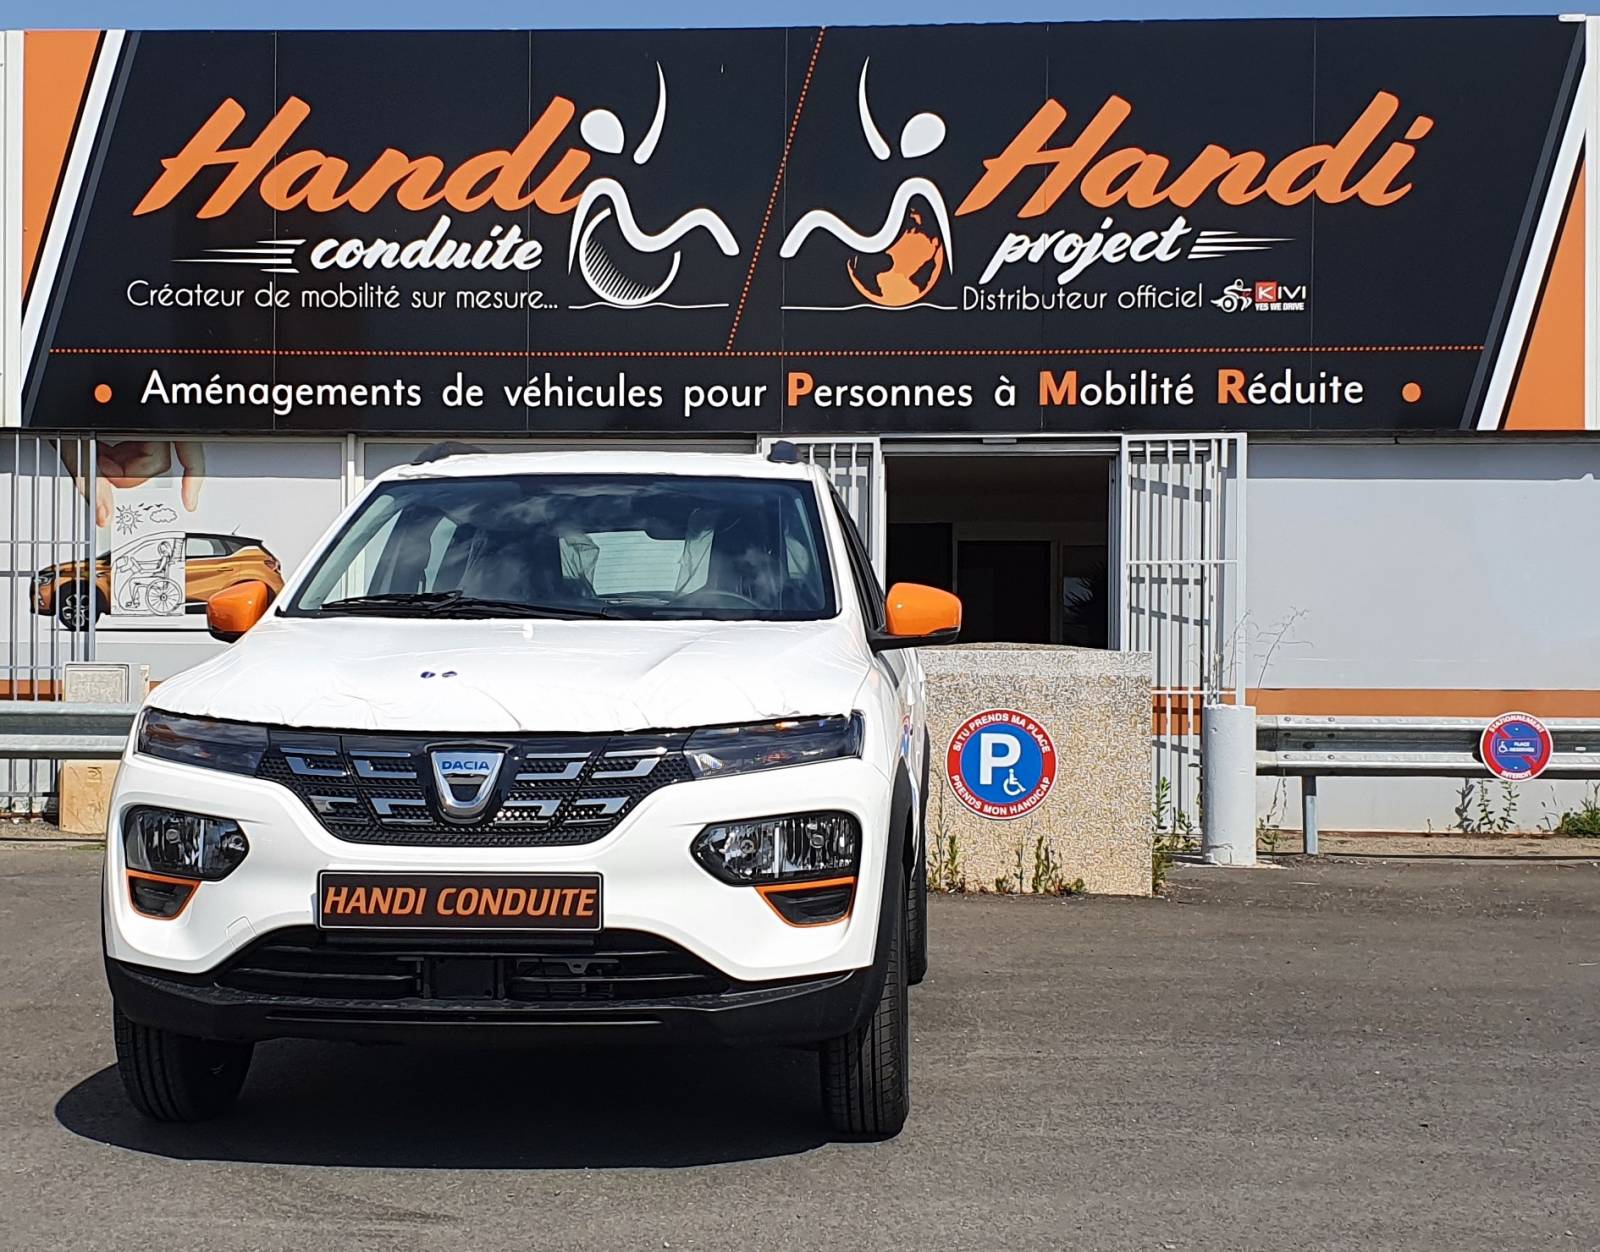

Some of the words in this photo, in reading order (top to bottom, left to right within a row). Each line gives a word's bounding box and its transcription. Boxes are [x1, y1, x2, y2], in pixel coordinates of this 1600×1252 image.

[133, 95, 592, 219] Handi
[955, 90, 1434, 218] Handi
[310, 215, 542, 272] conduite
[979, 216, 1193, 285] project
[127, 280, 244, 309] Créateur
[254, 281, 291, 309] de
[300, 281, 399, 309] mobilité
[411, 289, 448, 309] sur
[456, 289, 559, 311] mesure...
[962, 285, 1108, 310] Distributeur
[1117, 283, 1203, 309] officiel
[1255, 302, 1269, 311] YES
[1270, 302, 1281, 311] WE
[1283, 302, 1304, 311] DRIVE
[1257, 285, 1306, 300] KIVI
[140, 370, 422, 416] Aménagements
[441, 371, 484, 407] de
[503, 373, 663, 408] véhicules
[683, 383, 767, 417] pour
[787, 371, 973, 408] Personnes
[994, 374, 1016, 407] à
[1039, 369, 1195, 406] Mobilité
[1217, 369, 1364, 405] Réduite
[957, 729, 970, 742] TU
[969, 713, 1009, 730] PRENDS
[1011, 714, 1026, 726] MA
[1026, 723, 1051, 753] PLACE
[441, 760, 490, 771] DACIA
[980, 733, 1021, 784] P
[951, 775, 982, 809] PRENDS
[983, 805, 1008, 815] MON
[1010, 776, 1051, 814] HANDICAP
[322, 886, 426, 915] HANDI
[436, 887, 597, 917] CONDUITE
